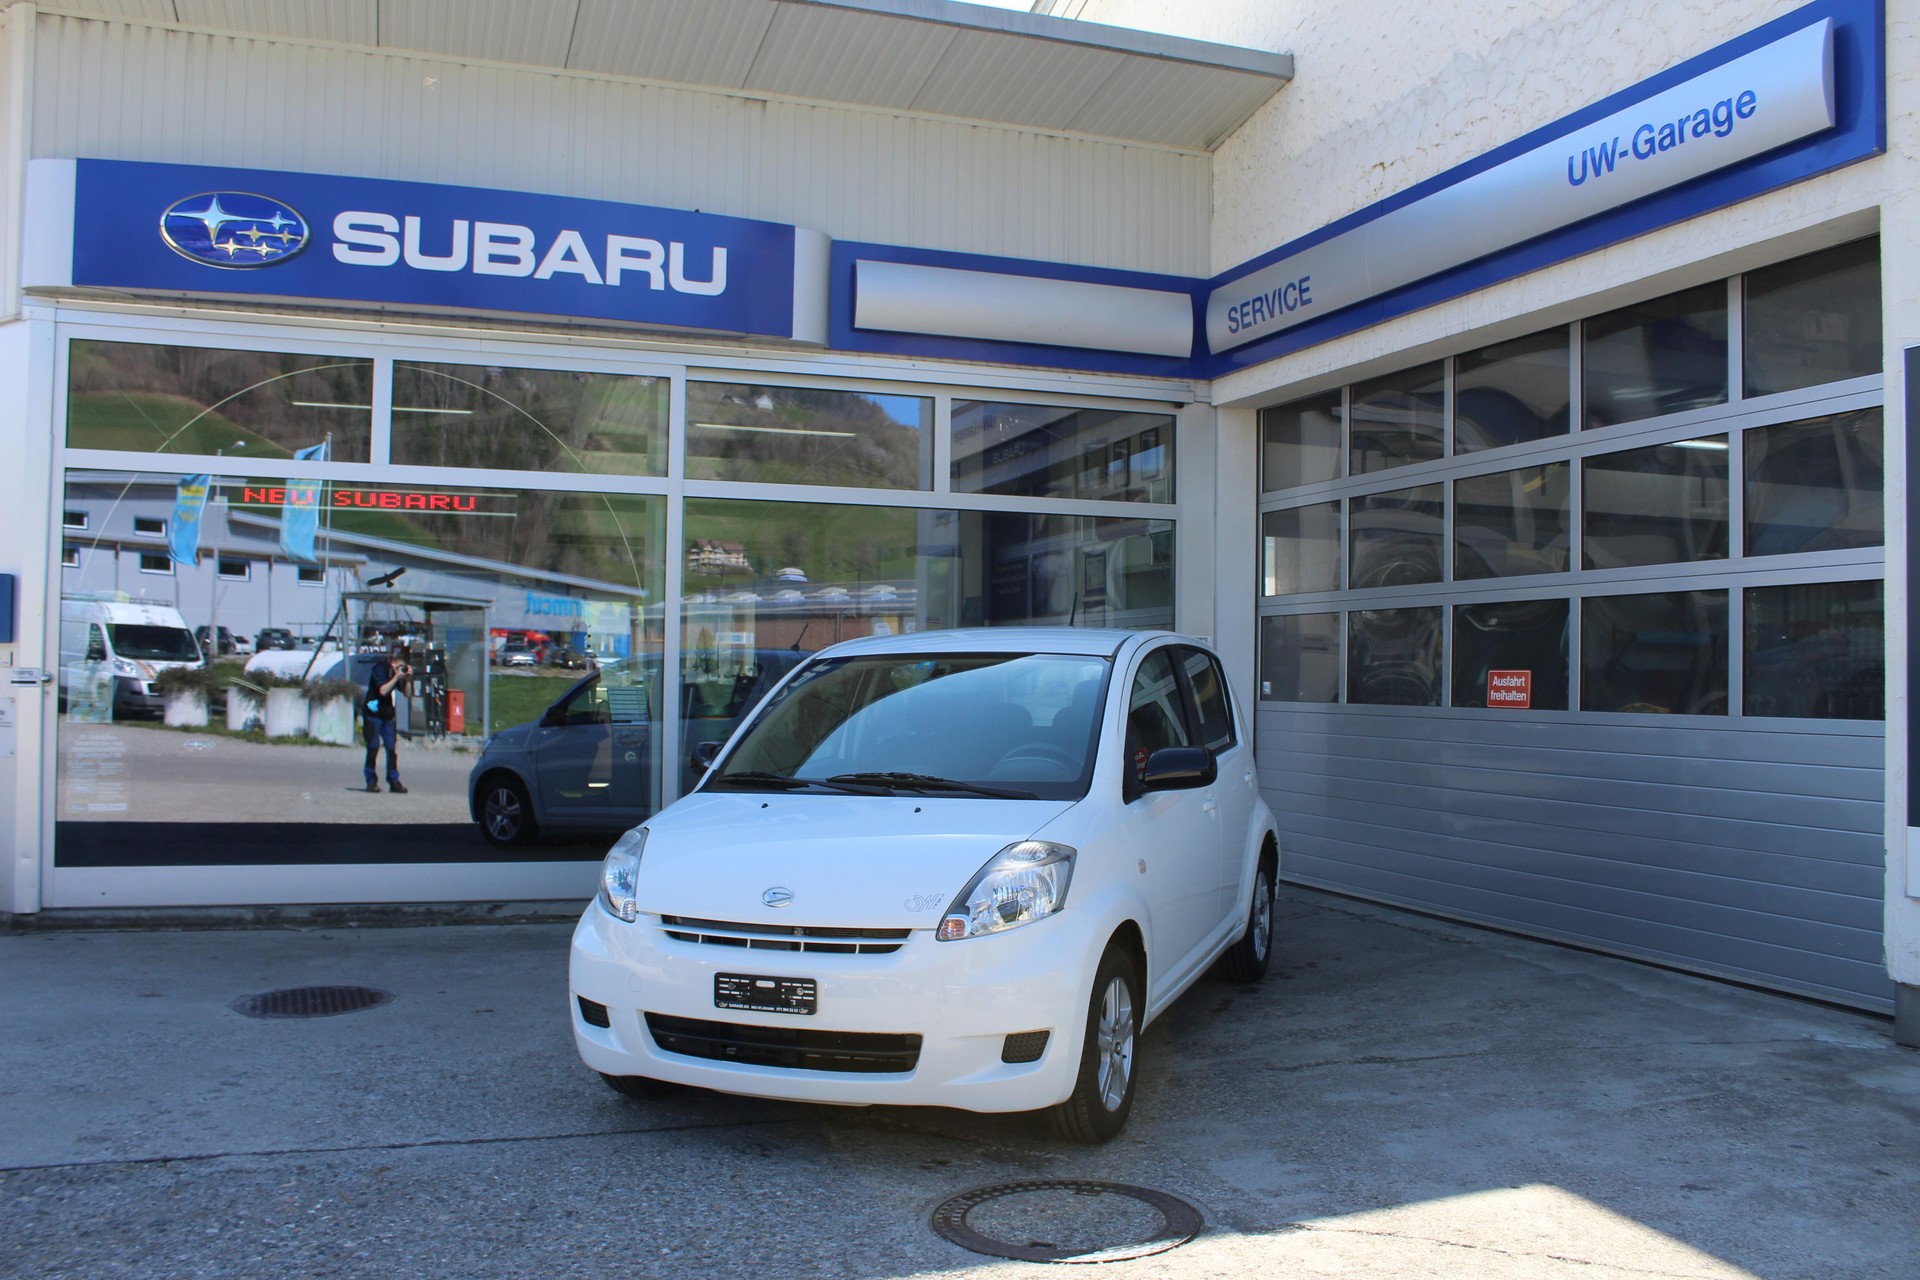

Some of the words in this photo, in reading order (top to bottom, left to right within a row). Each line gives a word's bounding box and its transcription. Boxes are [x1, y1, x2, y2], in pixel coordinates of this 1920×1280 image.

[1567, 89, 1757, 187] UW-Garage
[332, 210, 728, 297] SUBARU
[1227, 275, 1313, 334] SERVICE
[243, 487, 314, 505] NEU
[334, 490, 476, 511] SUBARU
[1490, 689, 1527, 701] freihalten
[1492, 675, 1526, 687] Ausfahrt
